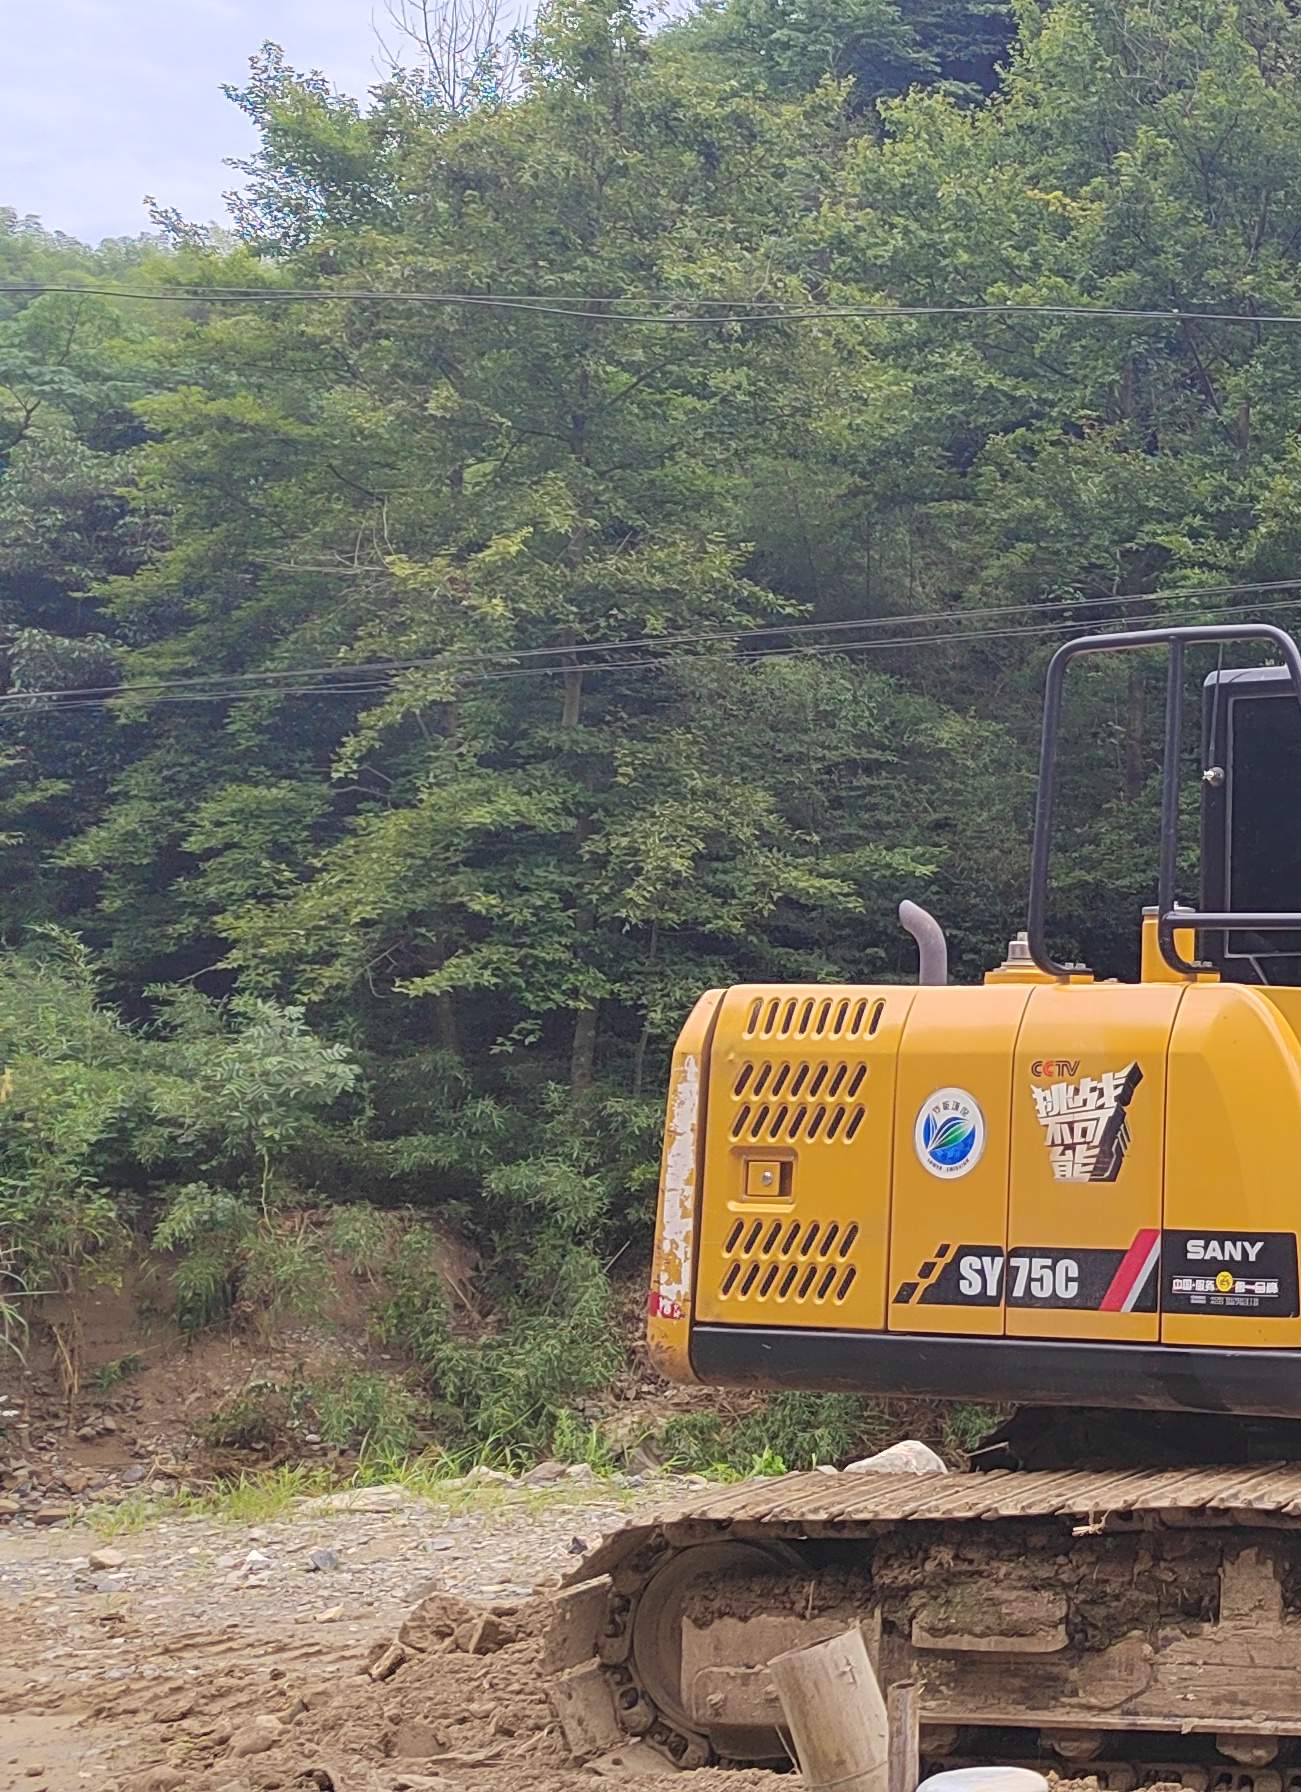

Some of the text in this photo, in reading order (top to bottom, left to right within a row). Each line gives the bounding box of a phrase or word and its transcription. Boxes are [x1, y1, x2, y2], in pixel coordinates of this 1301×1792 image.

[1031, 1060, 1080, 1078] CCTV
[1030, 1063, 1136, 1117] 挑战
[1040, 1107, 1115, 1147] 不可
[1051, 1144, 1101, 1182] 能
[1186, 1239, 1265, 1262] SANY
